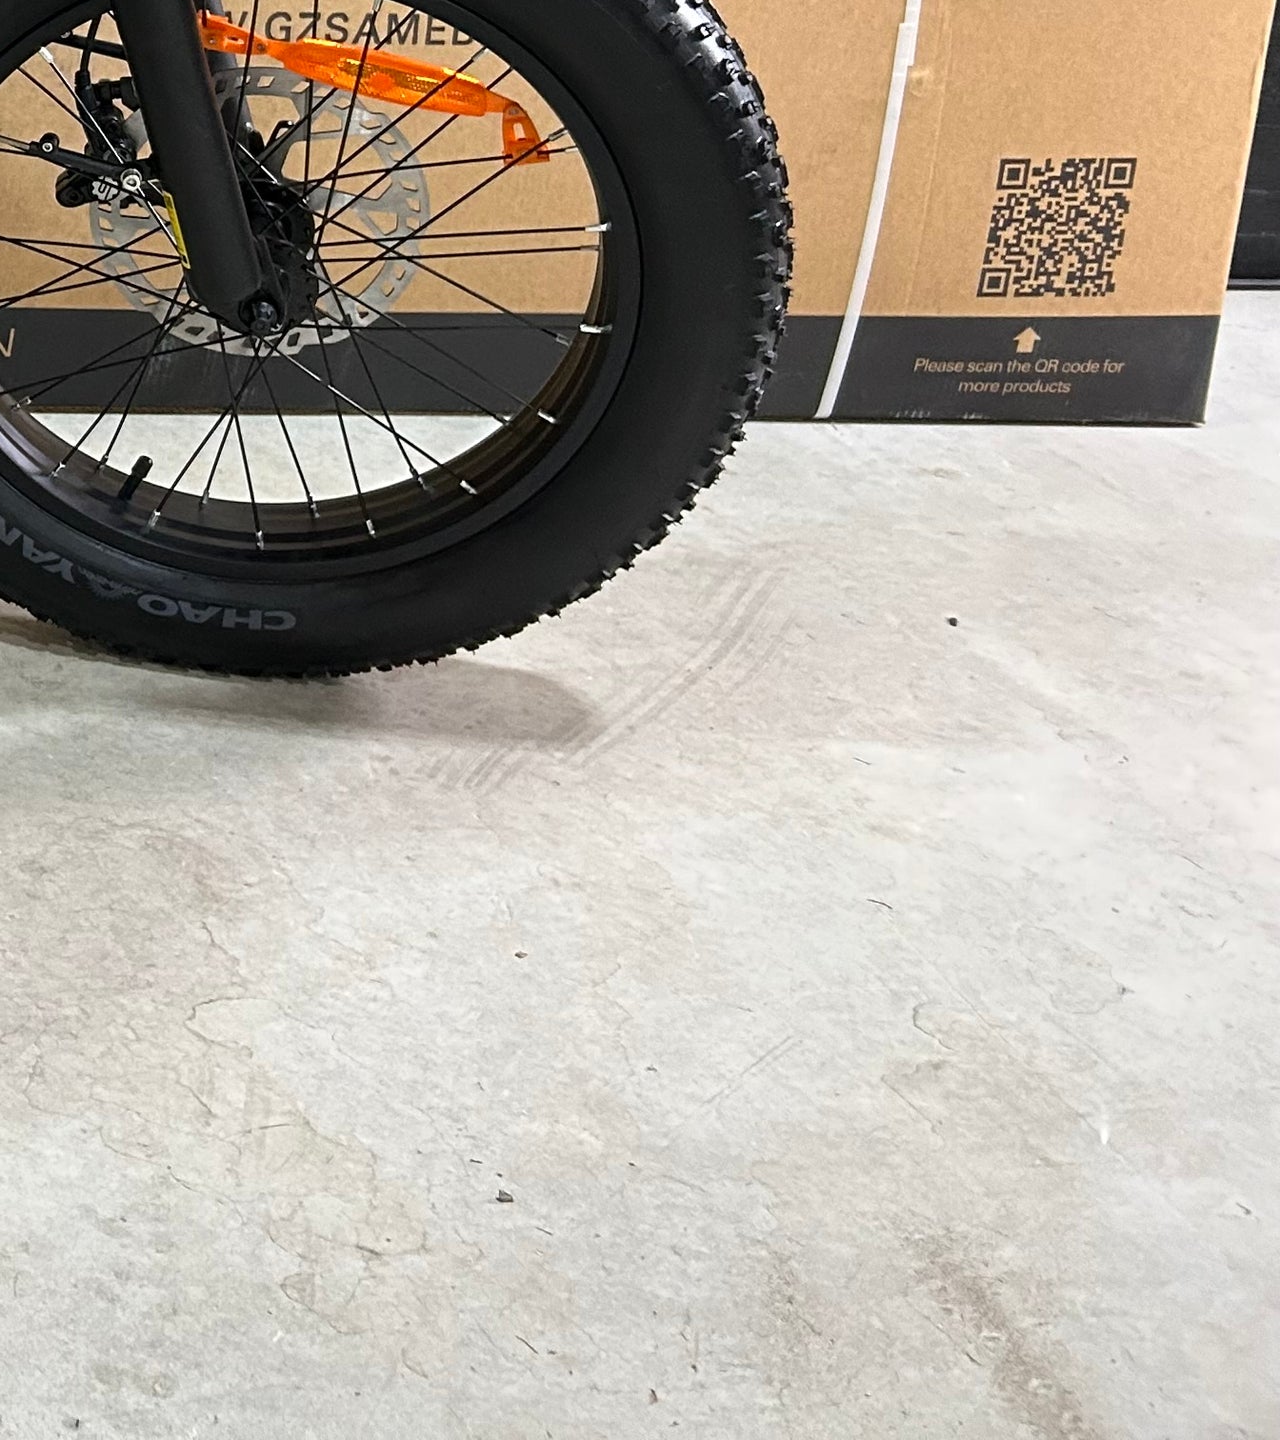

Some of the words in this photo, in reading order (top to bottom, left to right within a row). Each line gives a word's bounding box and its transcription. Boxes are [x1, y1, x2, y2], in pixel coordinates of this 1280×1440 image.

[913, 357, 964, 374] Please
[966, 360, 1003, 374] scan
[1006, 359, 1031, 374] the
[1034, 358, 1059, 375] QR
[1061, 359, 1100, 374] code
[1102, 358, 1126, 374] for
[958, 380, 999, 394] more
[1001, 379, 1072, 397] products
[137, 593, 297, 632] CHAO
